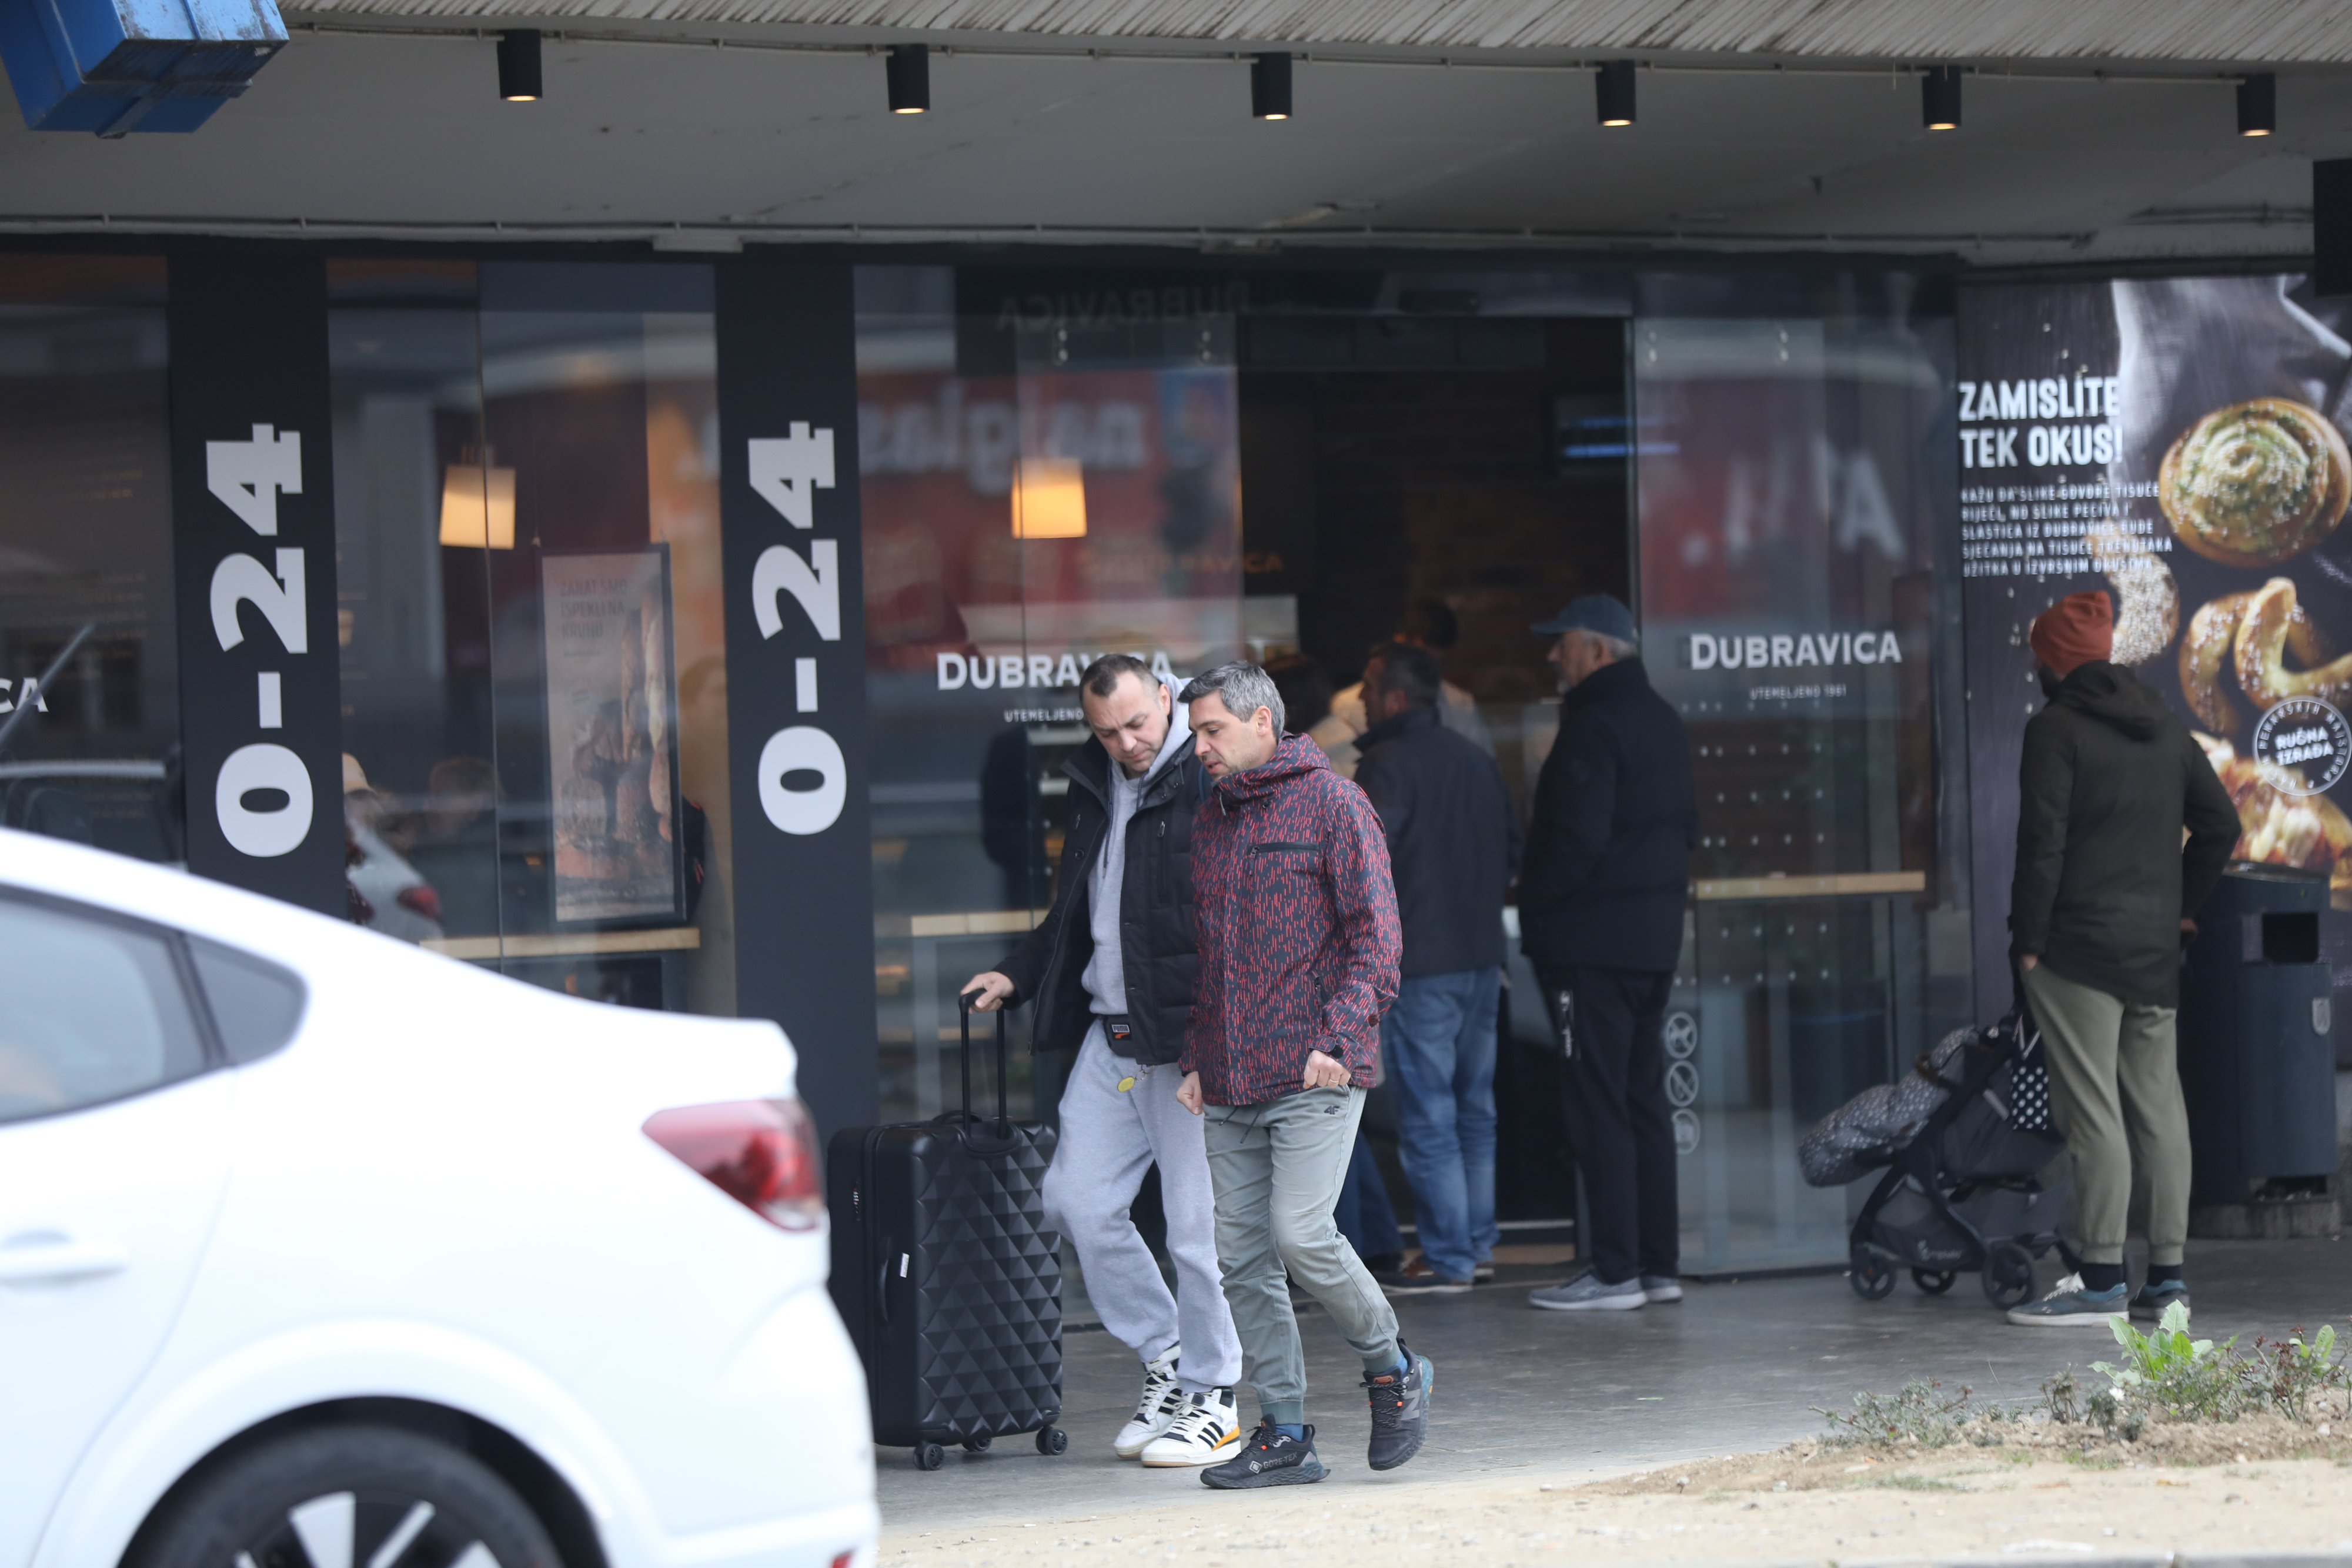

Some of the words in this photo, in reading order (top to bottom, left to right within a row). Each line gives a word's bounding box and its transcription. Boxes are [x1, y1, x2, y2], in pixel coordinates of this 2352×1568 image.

[1959, 376, 2119, 422] ZAMISLITE
[1960, 428, 2019, 469] TEK
[2027, 423, 2123, 467] OKUS!
[1997, 486, 2016, 502] DA
[2019, 484, 2055, 502] SLIKE
[2009, 503, 2029, 520] NO
[2032, 502, 2069, 520] SLIKE
[1961, 522, 2023, 540] SLASTICA
[2026, 540, 2044, 557] NA
[2011, 559, 2022, 576] U
[748, 420, 847, 835] 0-24
[206, 423, 313, 858] 0-24
[1689, 631, 1902, 670] DUBRAVICA
[1749, 683, 1821, 700] UTEMELJENO
[1004, 707, 1084, 723] UTEMELJENO
[1324, 1105, 1341, 1115] 4F
[1263, 1452, 1298, 1469] GORE-TEX
